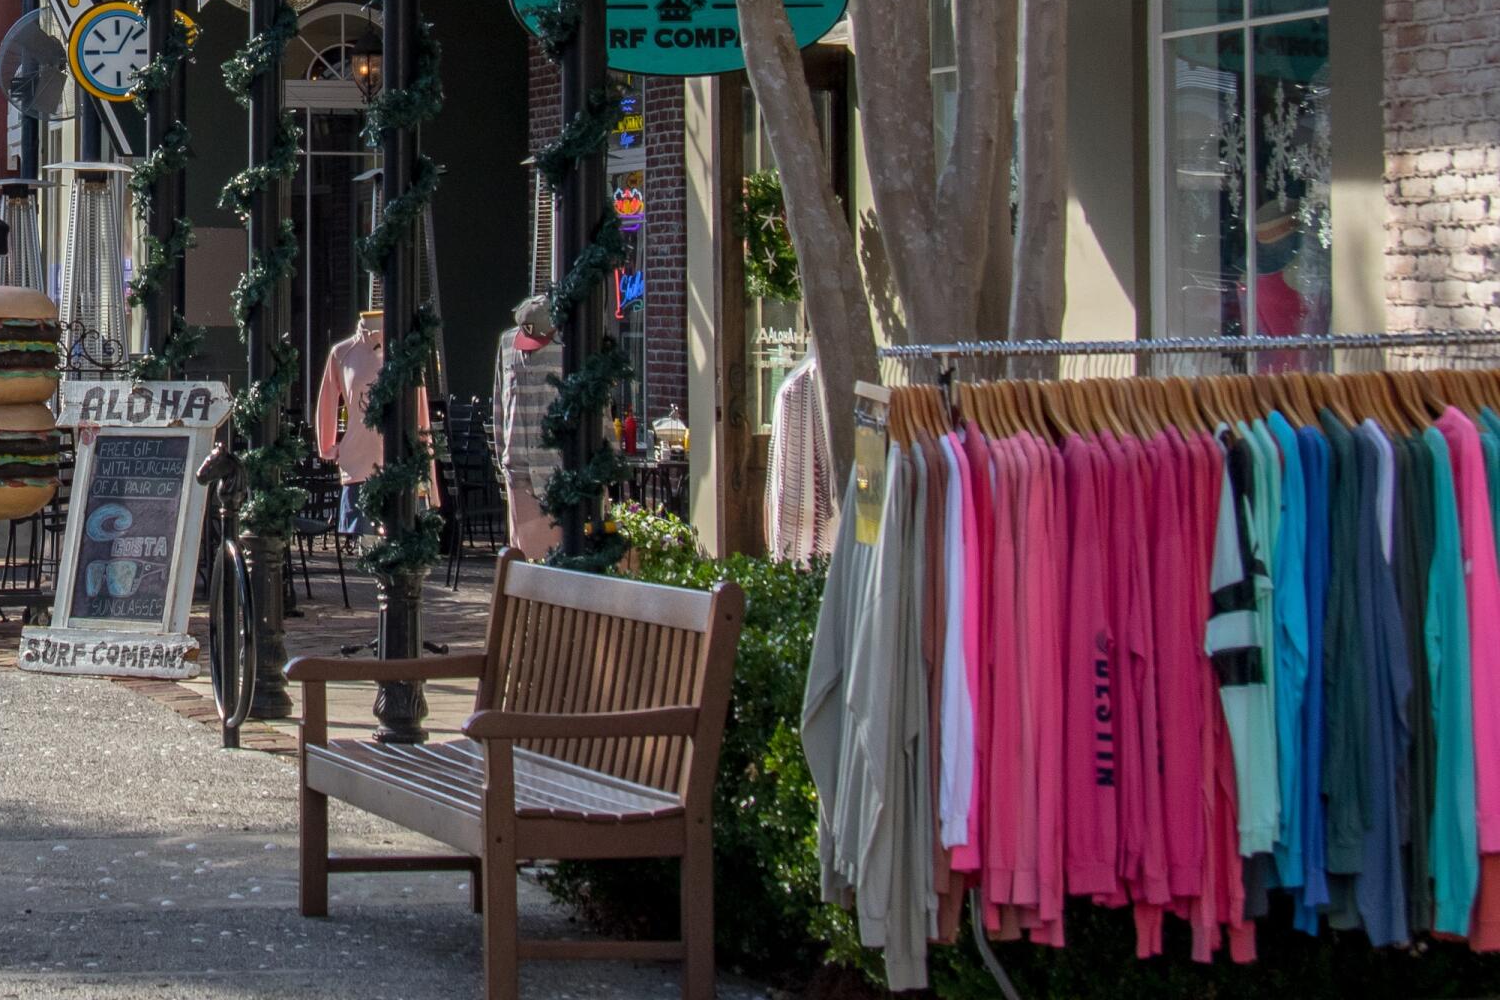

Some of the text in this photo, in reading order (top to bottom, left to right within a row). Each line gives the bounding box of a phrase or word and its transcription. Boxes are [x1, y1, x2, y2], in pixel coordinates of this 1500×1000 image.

[80, 386, 212, 424] ALOHA
[100, 440, 164, 457] FREE GIFT
[102, 460, 131, 476] WITH
[92, 481, 175, 495] OF A PAIR OF
[111, 536, 167, 557] COSTA
[92, 599, 163, 617] SUNGLASSES
[25, 638, 186, 669] SURF COMPANY
